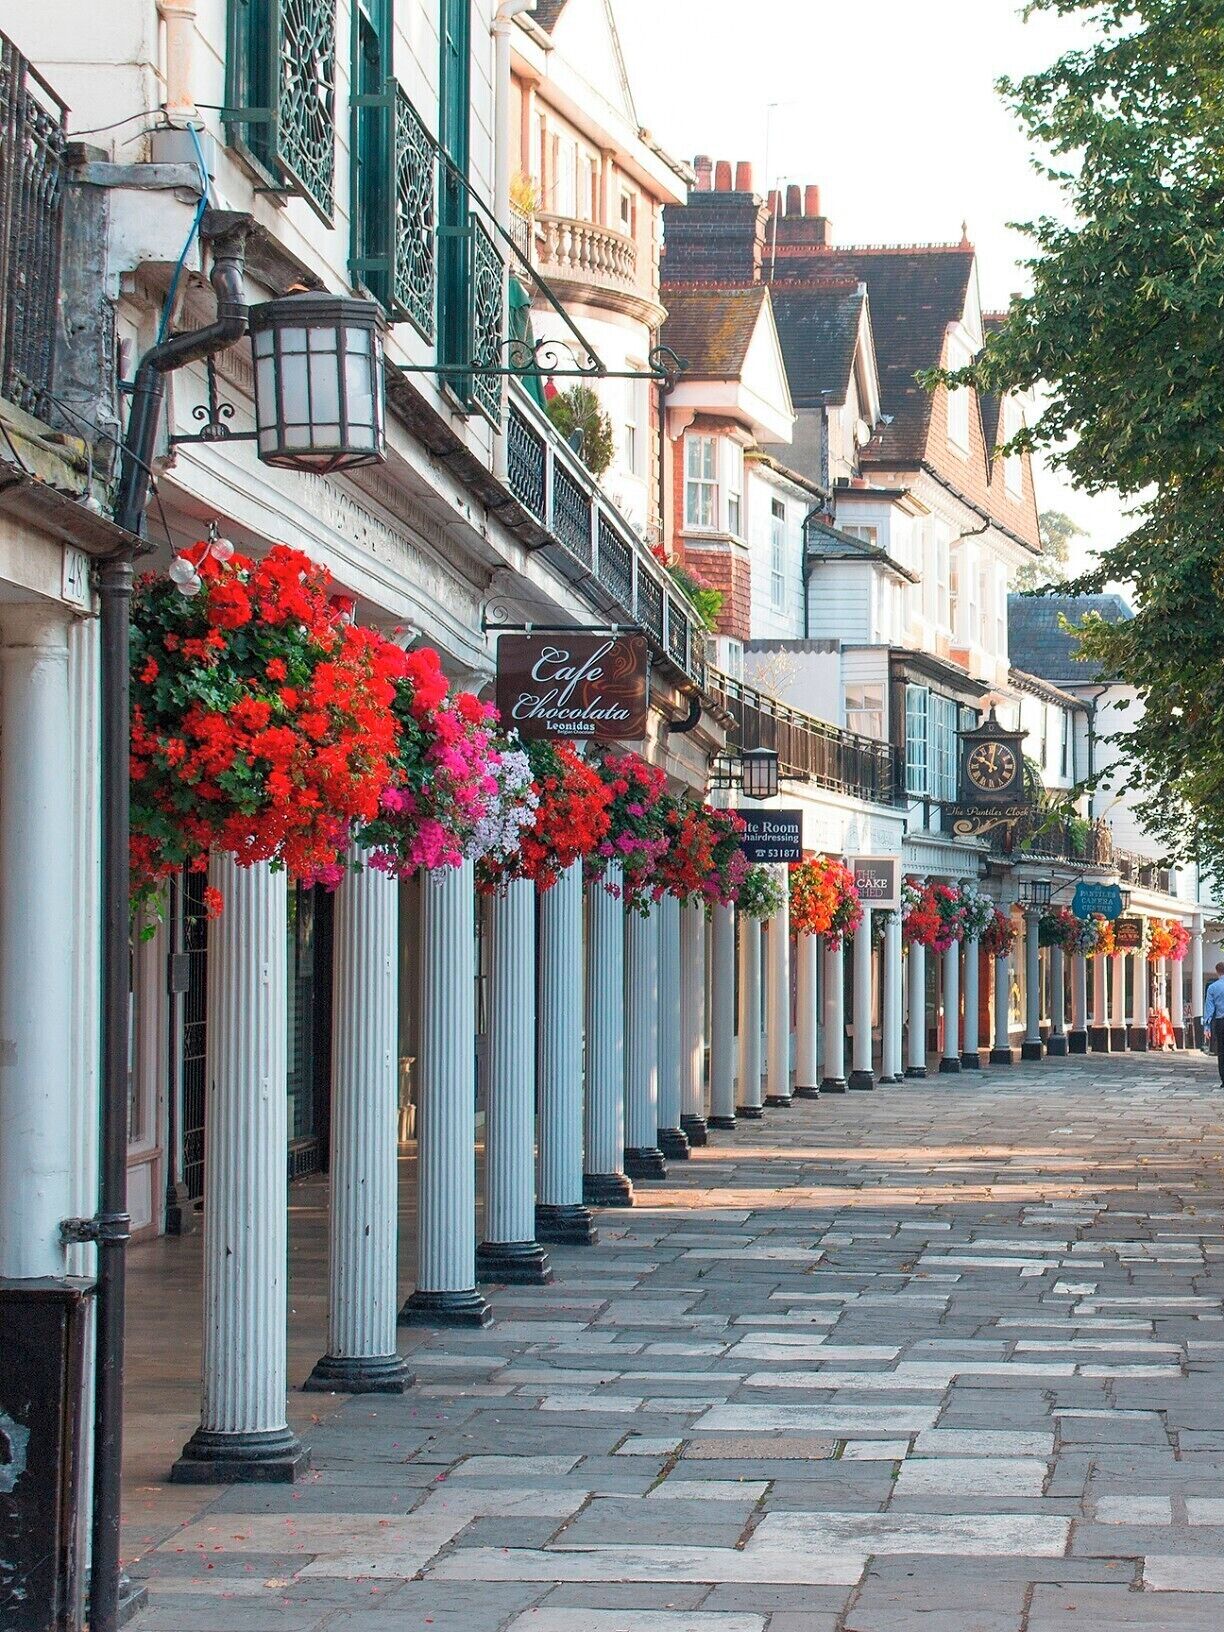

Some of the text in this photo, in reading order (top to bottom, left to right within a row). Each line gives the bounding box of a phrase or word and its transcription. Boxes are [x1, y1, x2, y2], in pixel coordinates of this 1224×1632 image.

[532, 640, 615, 707] Cafe
[511, 688, 631, 720] Chocolata
[546, 721, 595, 731] Leonidas
[1005, 807, 1029, 816] Clock
[763, 822, 799, 833] Room
[768, 849, 799, 858] 531871
[857, 870, 876, 879] THE
[857, 879, 888, 888] CAKE
